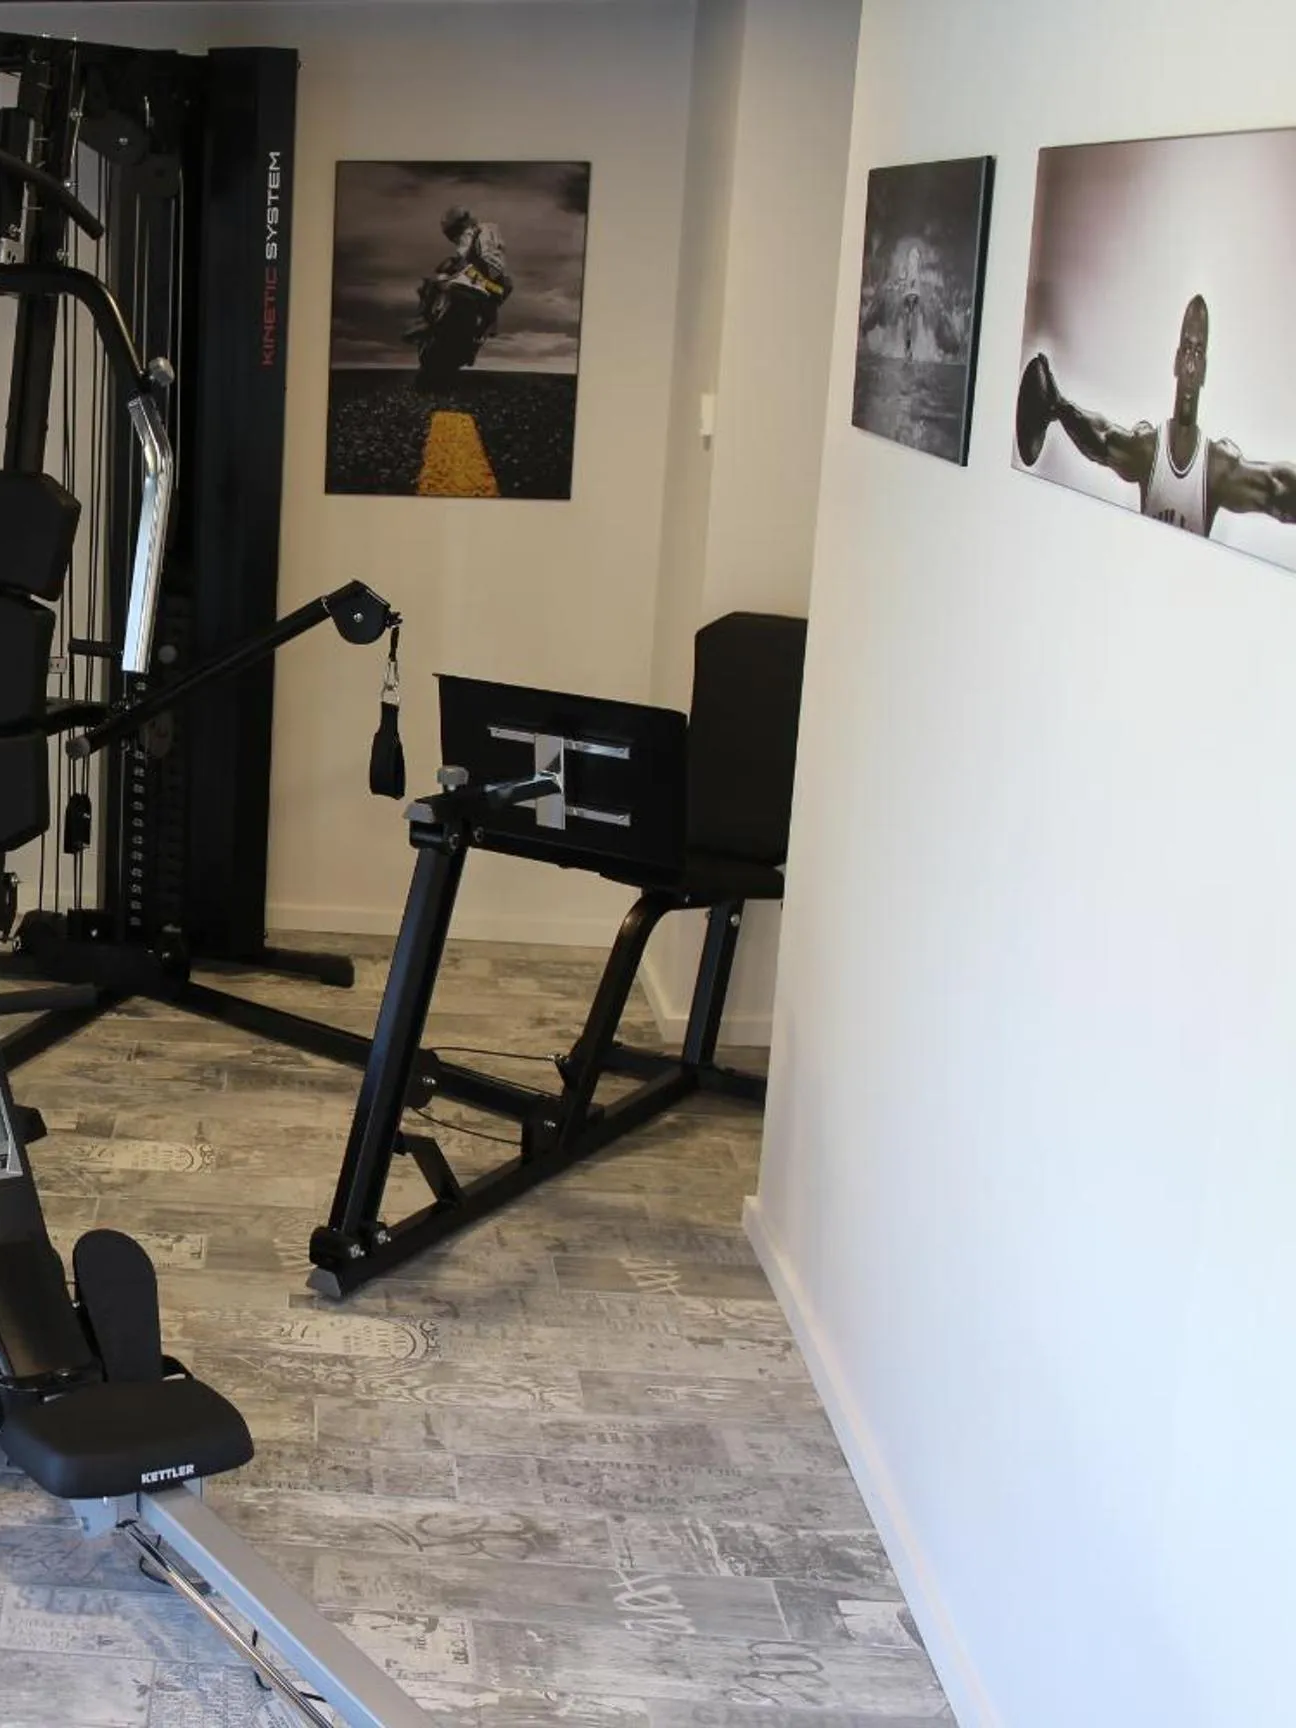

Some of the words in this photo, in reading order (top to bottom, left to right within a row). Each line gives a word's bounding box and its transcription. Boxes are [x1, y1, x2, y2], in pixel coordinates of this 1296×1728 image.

[265, 151, 281, 260] SYSTEM
[262, 267, 278, 365] KINETIC
[141, 1463, 195, 1484] KETTLER
